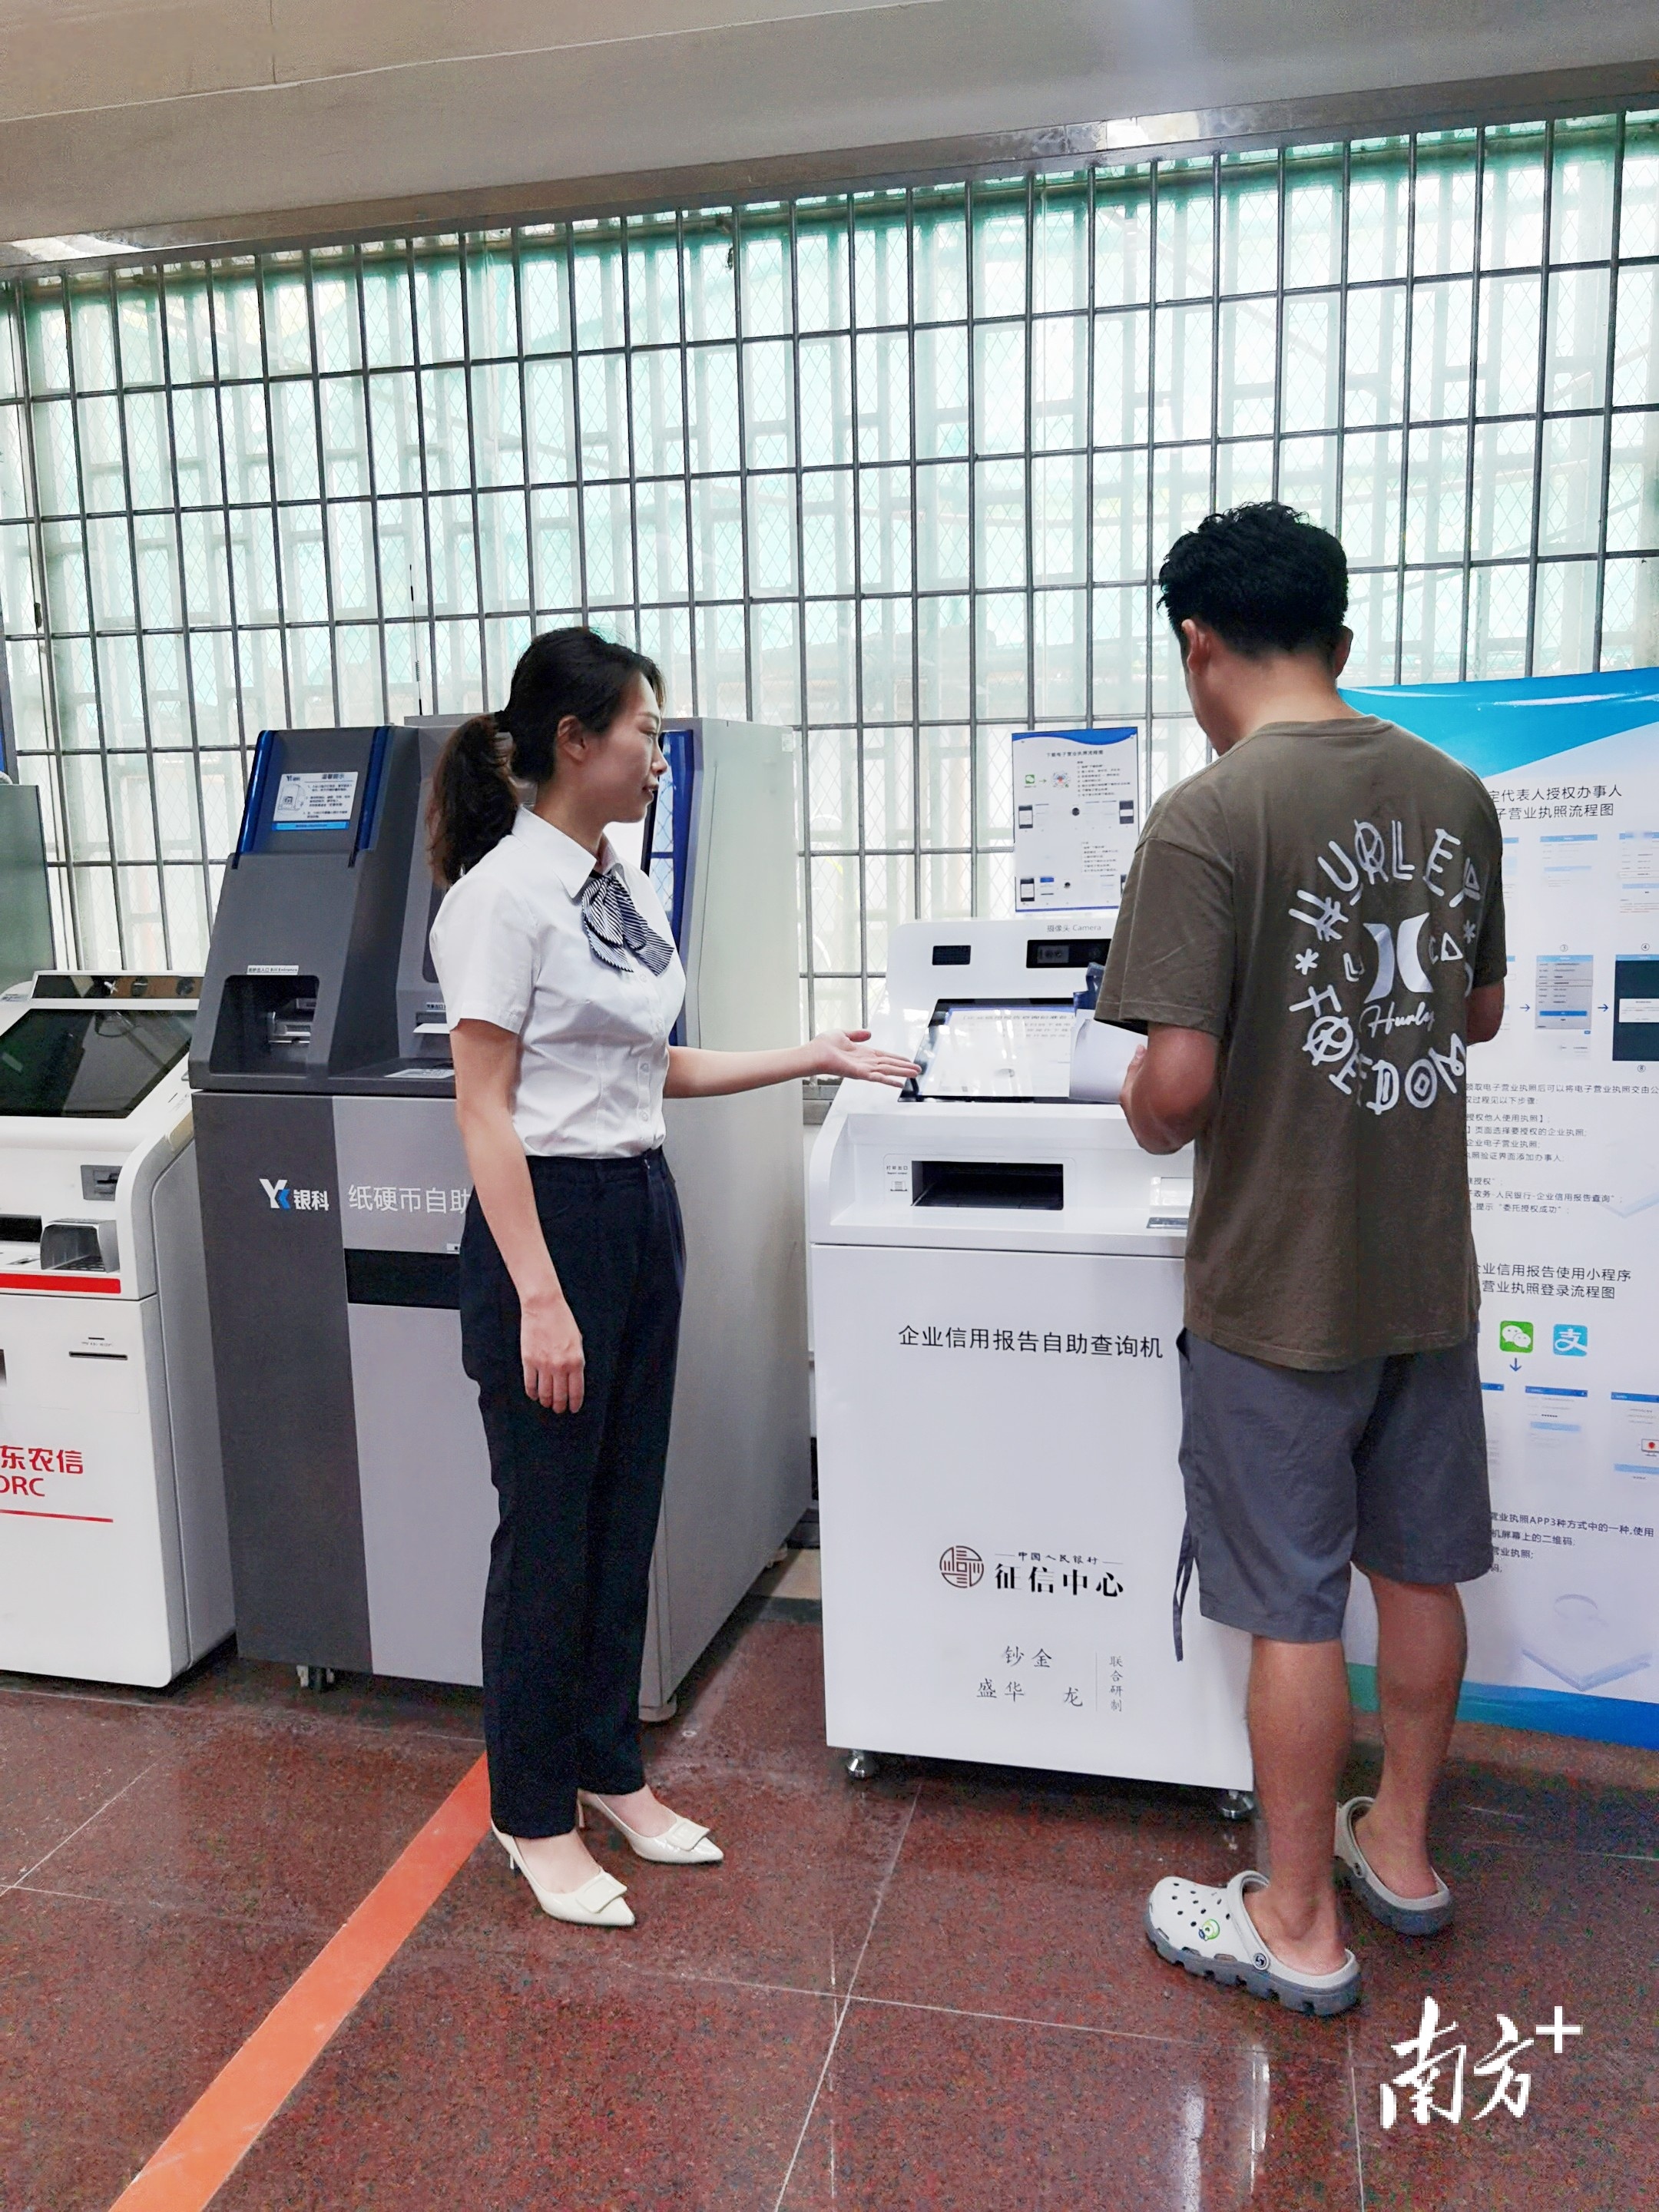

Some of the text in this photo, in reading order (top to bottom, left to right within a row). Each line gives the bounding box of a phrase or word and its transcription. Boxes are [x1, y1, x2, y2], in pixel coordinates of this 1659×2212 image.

[1489, 784, 1622, 803] 定代表人授权办事人
[1496, 803, 1614, 820] 子营业执照流程图
[293, 1190, 329, 1211] 银科
[348, 1184, 471, 1214] 纸硬币自助
[1482, 1280, 1615, 1299] 营业执照登录流程图
[898, 1325, 1164, 1358] 企业信用报告自助查询机
[0, 1445, 83, 1474] 东农信
[1018, 1551, 1098, 1565] 中国人民银行
[995, 1563, 1123, 1597] 征信中心
[1004, 1645, 1051, 1667] 钞金
[1109, 1656, 1123, 1712] 联合研制
